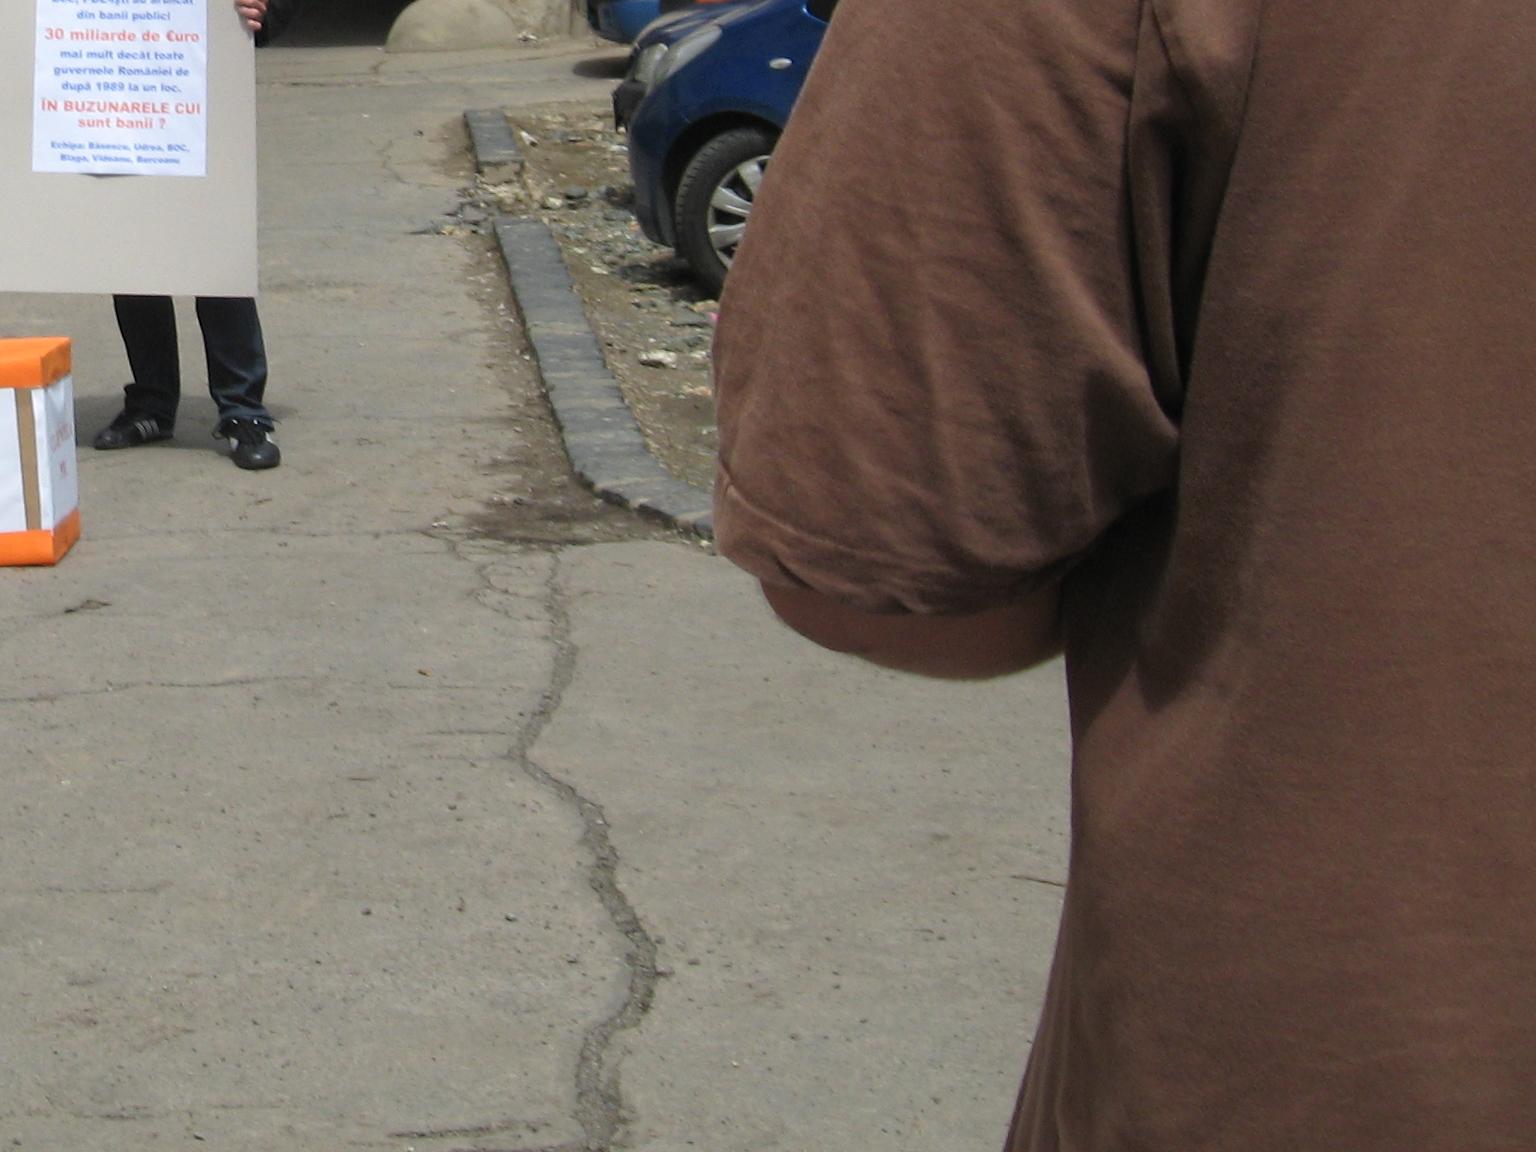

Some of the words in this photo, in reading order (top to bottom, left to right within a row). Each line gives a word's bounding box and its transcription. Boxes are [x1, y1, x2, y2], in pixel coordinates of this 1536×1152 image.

[76, 9, 96, 20] din
[99, 10, 128, 20] banii
[132, 11, 171, 22] publici
[44, 28, 64, 40] 30
[70, 29, 136, 42] miliarde
[141, 29, 160, 42] de
[60, 50, 82, 60] mai
[86, 50, 114, 60] mult
[154, 51, 184, 60] toate
[53, 66, 114, 77] guvernele
[175, 67, 190, 77] de
[96, 82, 125, 92] 1989
[128, 82, 140, 92] la
[143, 84, 157, 92] un
[41, 98, 58, 112] ÎN
[64, 99, 170, 114] BUZUNARELE
[174, 102, 201, 115] CUI
[78, 118, 111, 128] sunt
[116, 118, 153, 129] banii
[158, 118, 166, 129] ?
